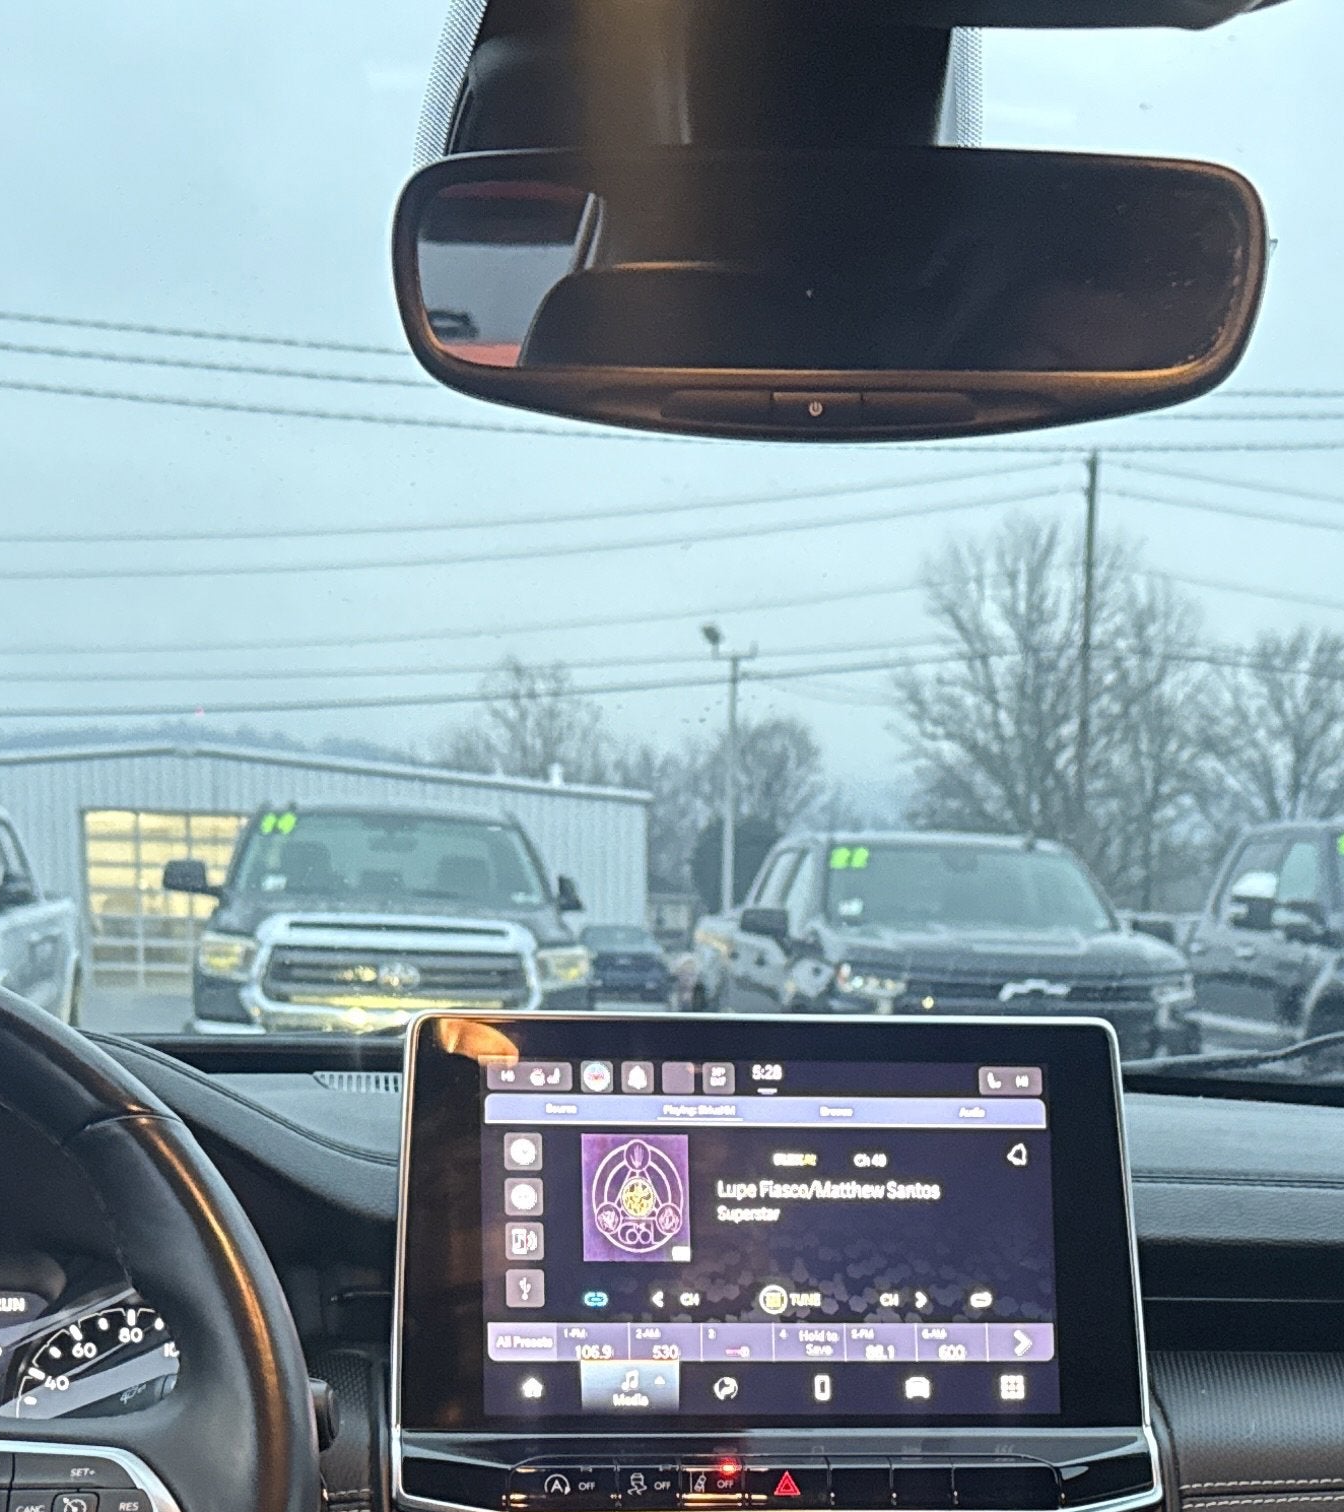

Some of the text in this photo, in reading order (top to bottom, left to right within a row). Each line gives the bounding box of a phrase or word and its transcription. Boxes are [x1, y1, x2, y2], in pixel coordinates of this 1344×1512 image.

[717, 1180, 941, 1200] Lupe Fiasco/Matthew Santos
[717, 1205, 781, 1224] Superstar
[118, 1327, 143, 1343] 80
[496, 1335, 513, 1348] All
[798, 1330, 840, 1343] Hold to
[72, 1342, 97, 1358] 60
[44, 1375, 70, 1391] 40
[612, 1392, 650, 1407] Media
[578, 1481, 596, 1491] OFF
[654, 1481, 672, 1491] OFF
[717, 1479, 734, 1489] OFF
[119, 1502, 139, 1512] RES
